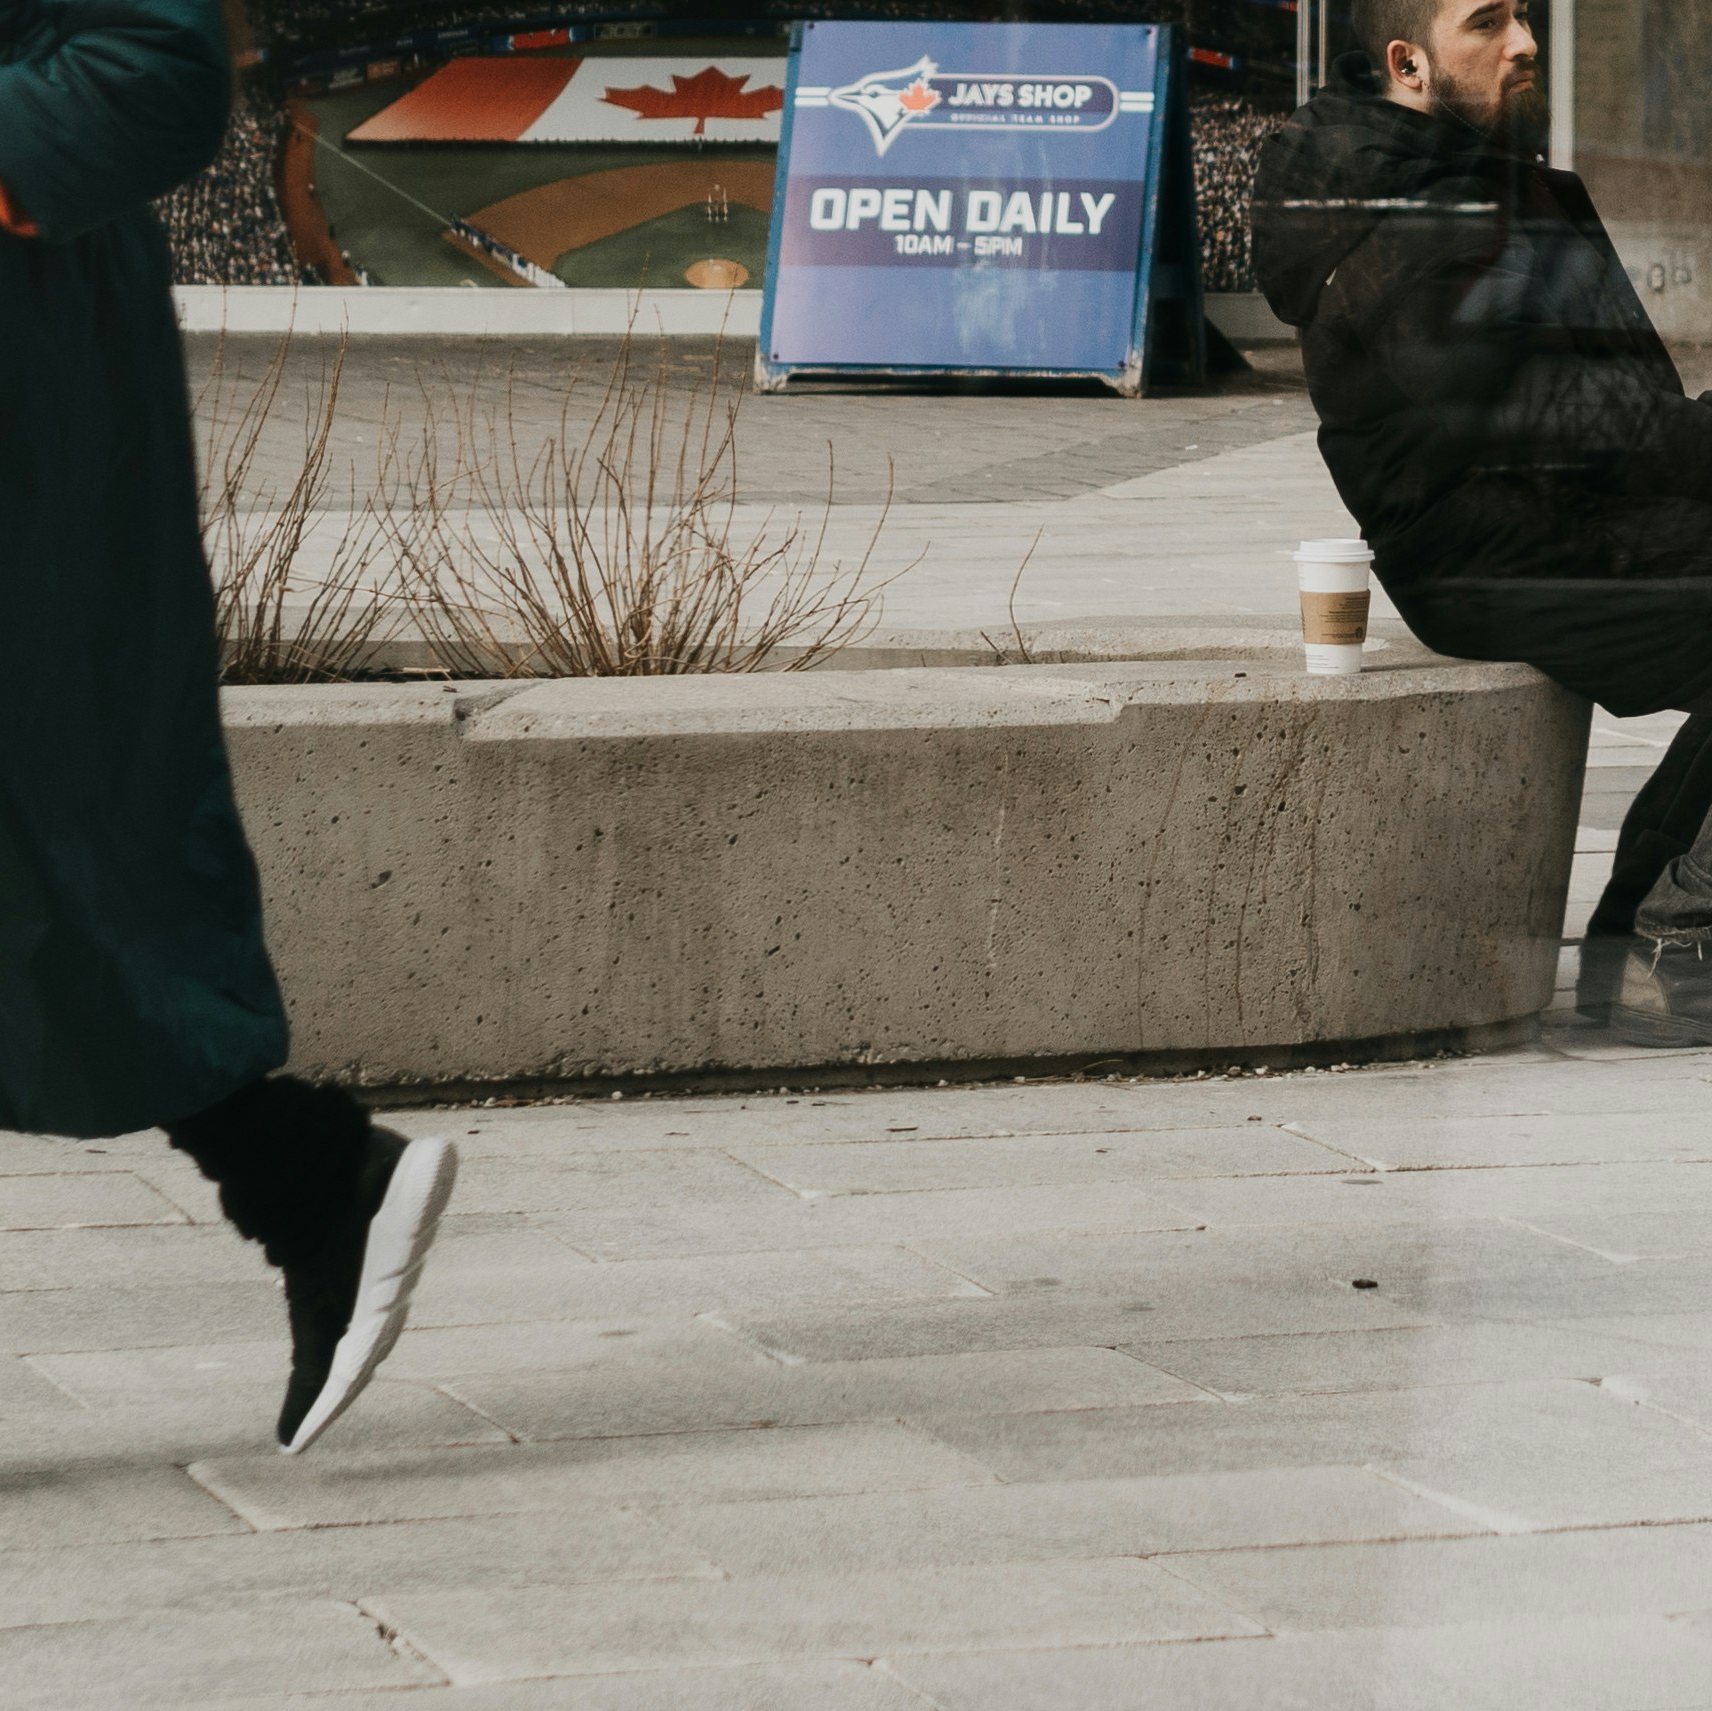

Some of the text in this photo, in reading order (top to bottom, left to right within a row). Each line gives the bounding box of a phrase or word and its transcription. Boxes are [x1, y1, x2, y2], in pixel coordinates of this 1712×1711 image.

[948, 82, 1092, 109] JAYS SHOP
[810, 187, 1116, 235] OPEN DAILY
[895, 234, 954, 256] 10AM
[974, 235, 1023, 256] 5PM
